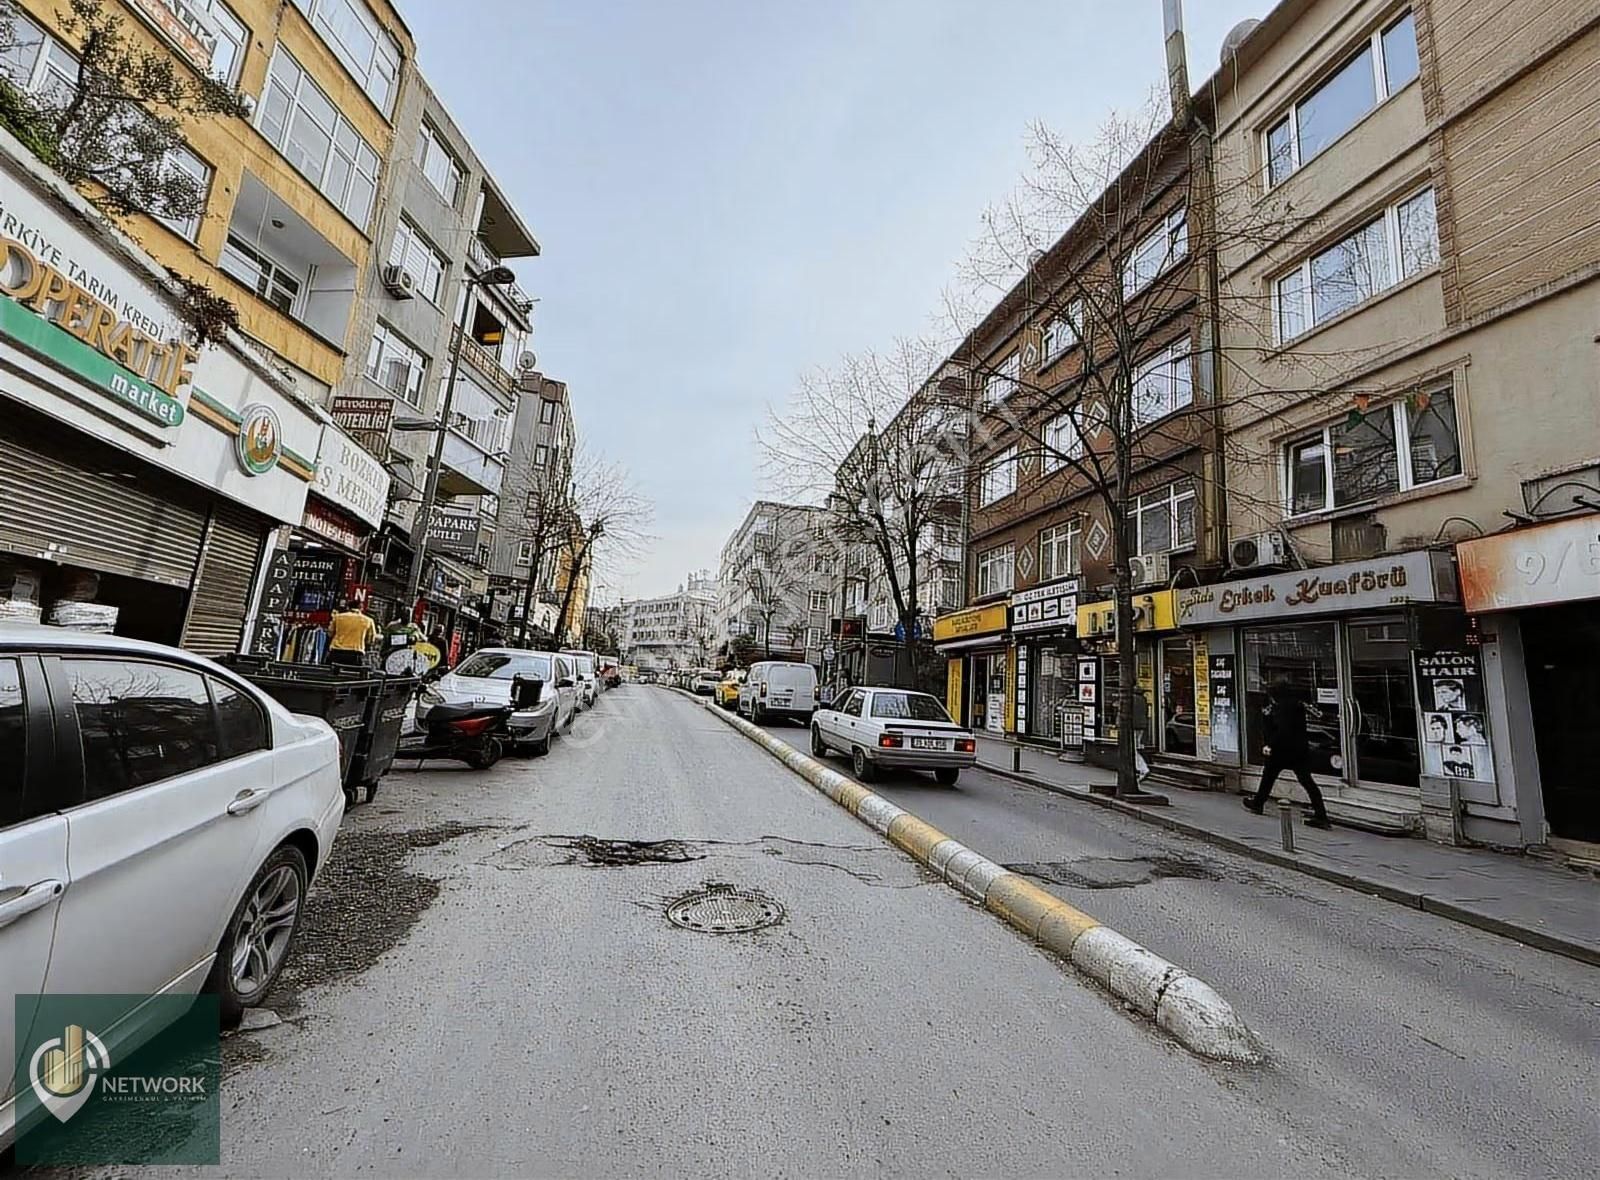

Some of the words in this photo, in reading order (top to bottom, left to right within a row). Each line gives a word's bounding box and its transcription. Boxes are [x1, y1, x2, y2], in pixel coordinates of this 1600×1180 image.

[68, 259, 118, 309] TARIM
[122, 302, 165, 341] KREDİ
[111, 373, 177, 422] market
[1419, 655, 1475, 666] SALON
